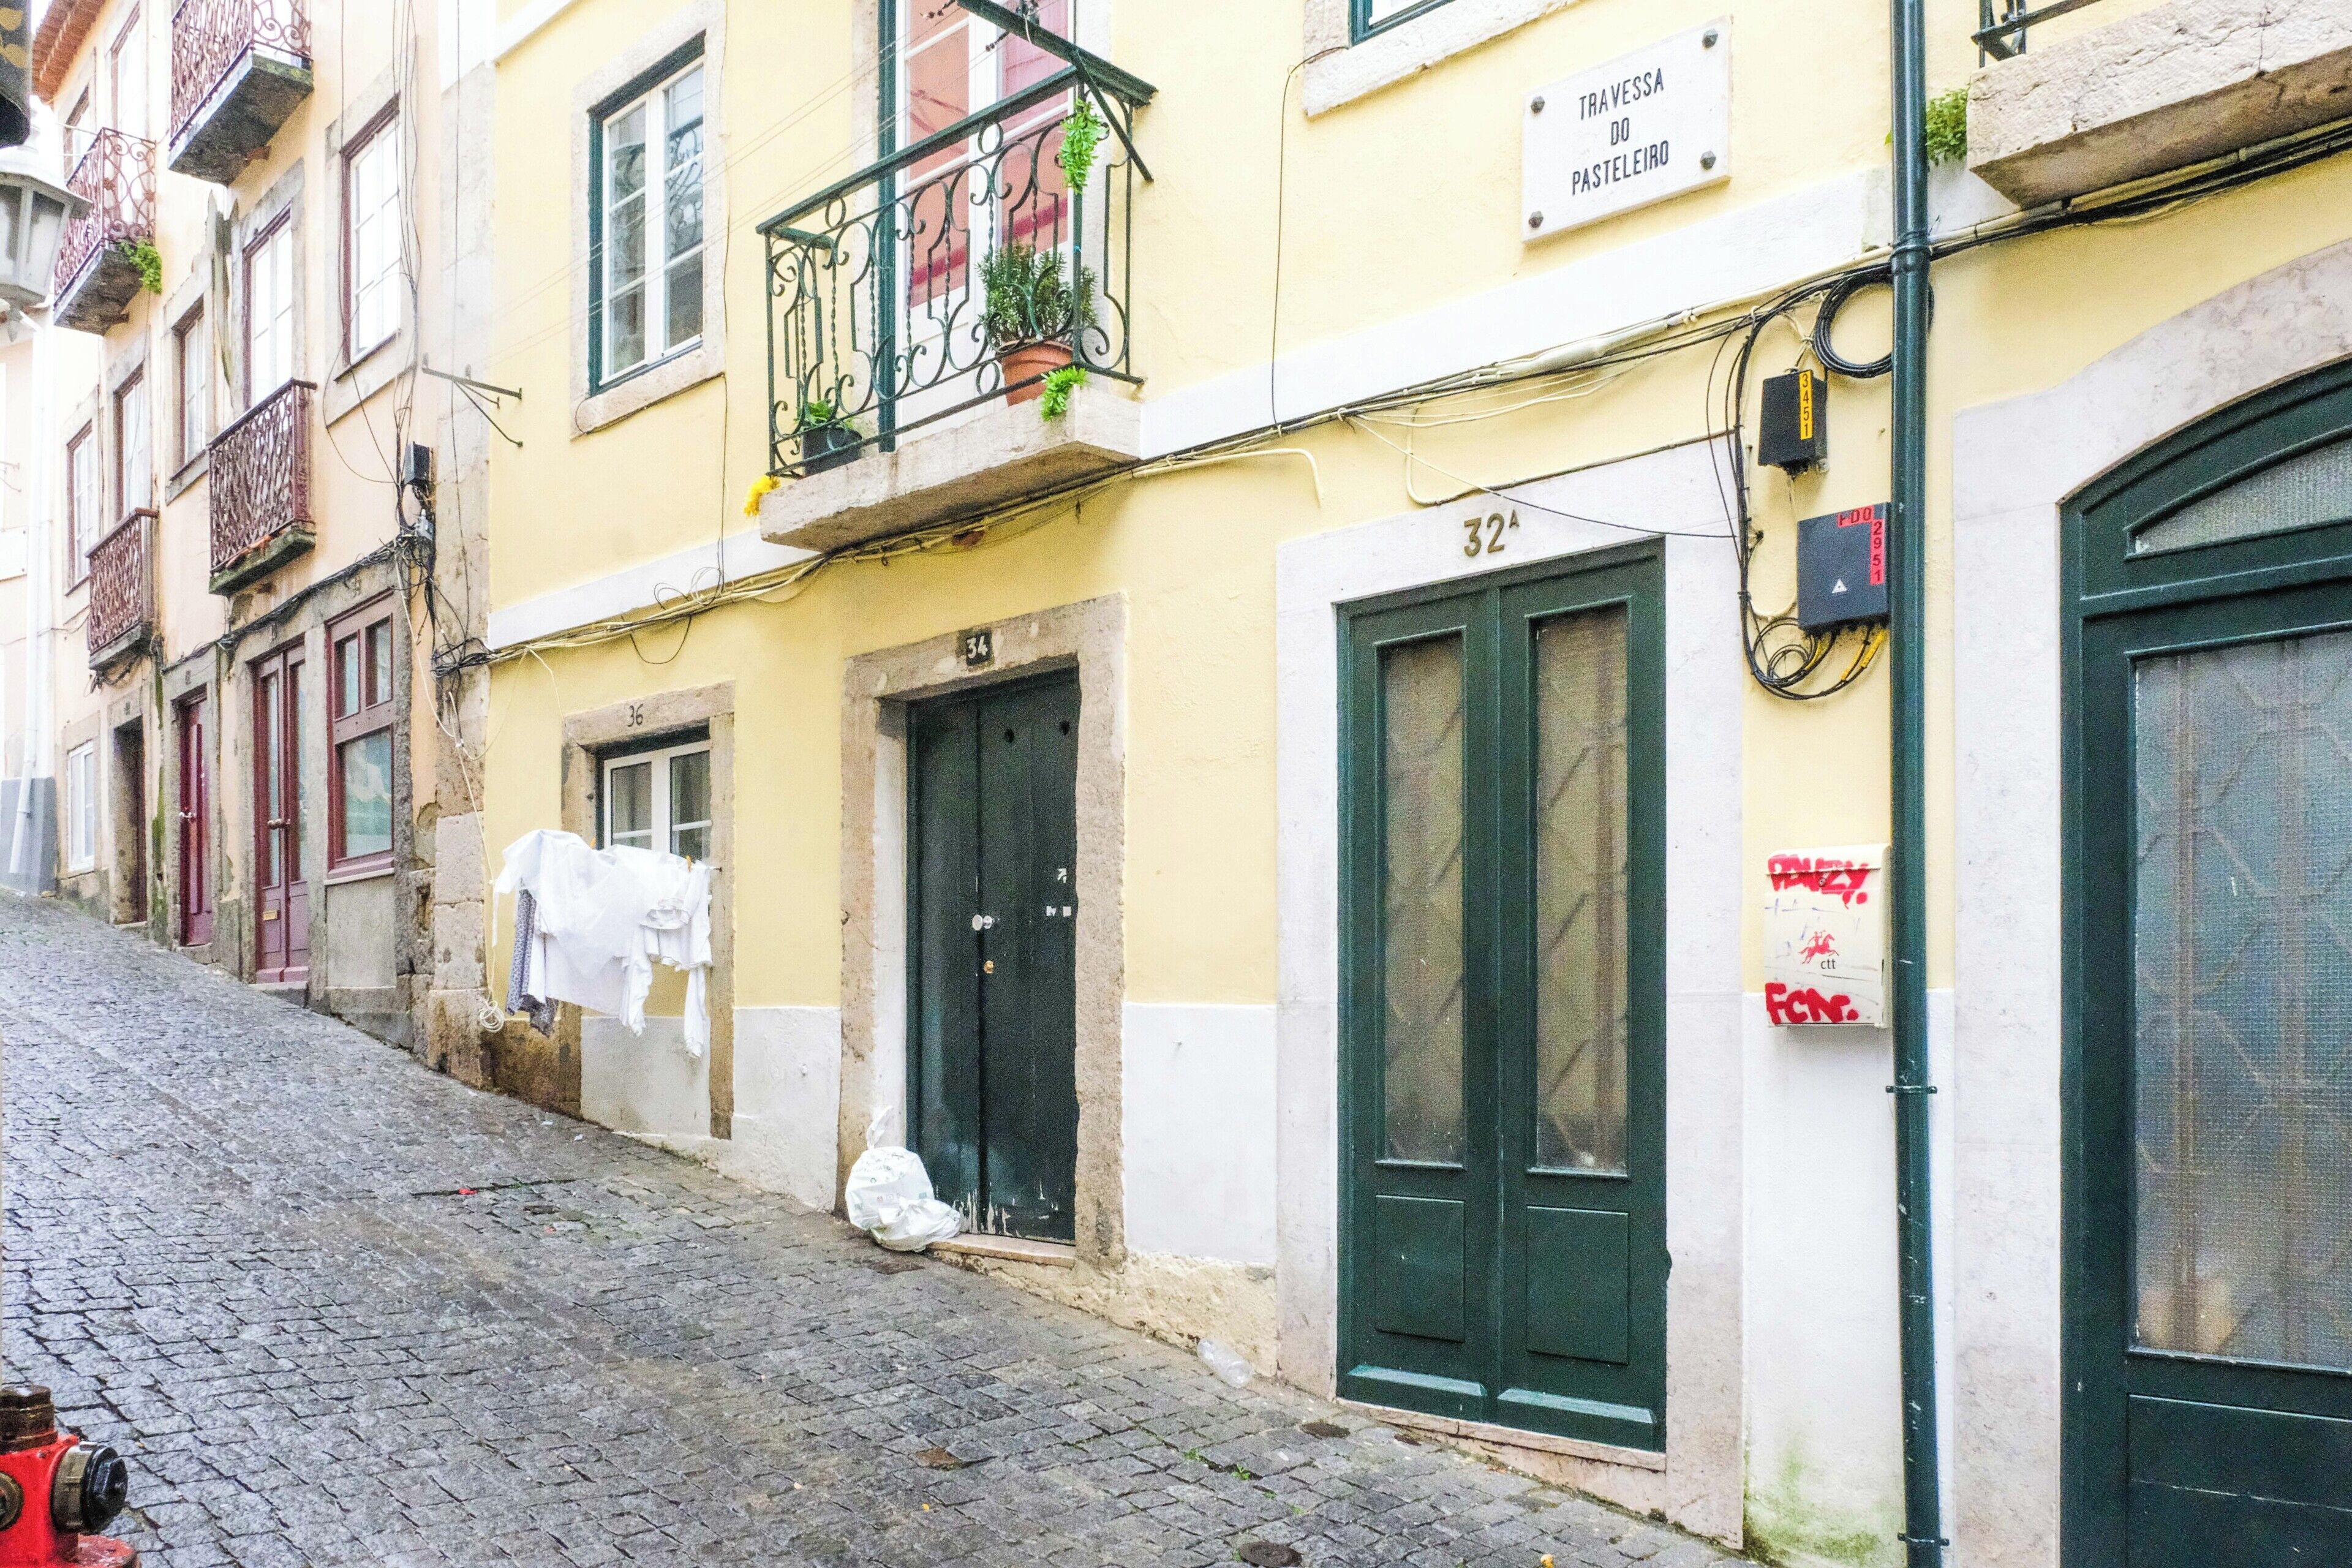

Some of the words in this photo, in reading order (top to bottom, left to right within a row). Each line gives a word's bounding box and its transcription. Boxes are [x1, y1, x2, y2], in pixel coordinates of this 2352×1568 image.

[1579, 68, 1664, 121] TRAVESSA
[1610, 118, 1629, 146] DO
[1572, 140, 1669, 195] PASTELEIRO
[1872, 521, 1882, 582] 2951
[967, 635, 988, 658] 34
[627, 703, 644, 727] 36
[1820, 959, 1836, 970] ctt
